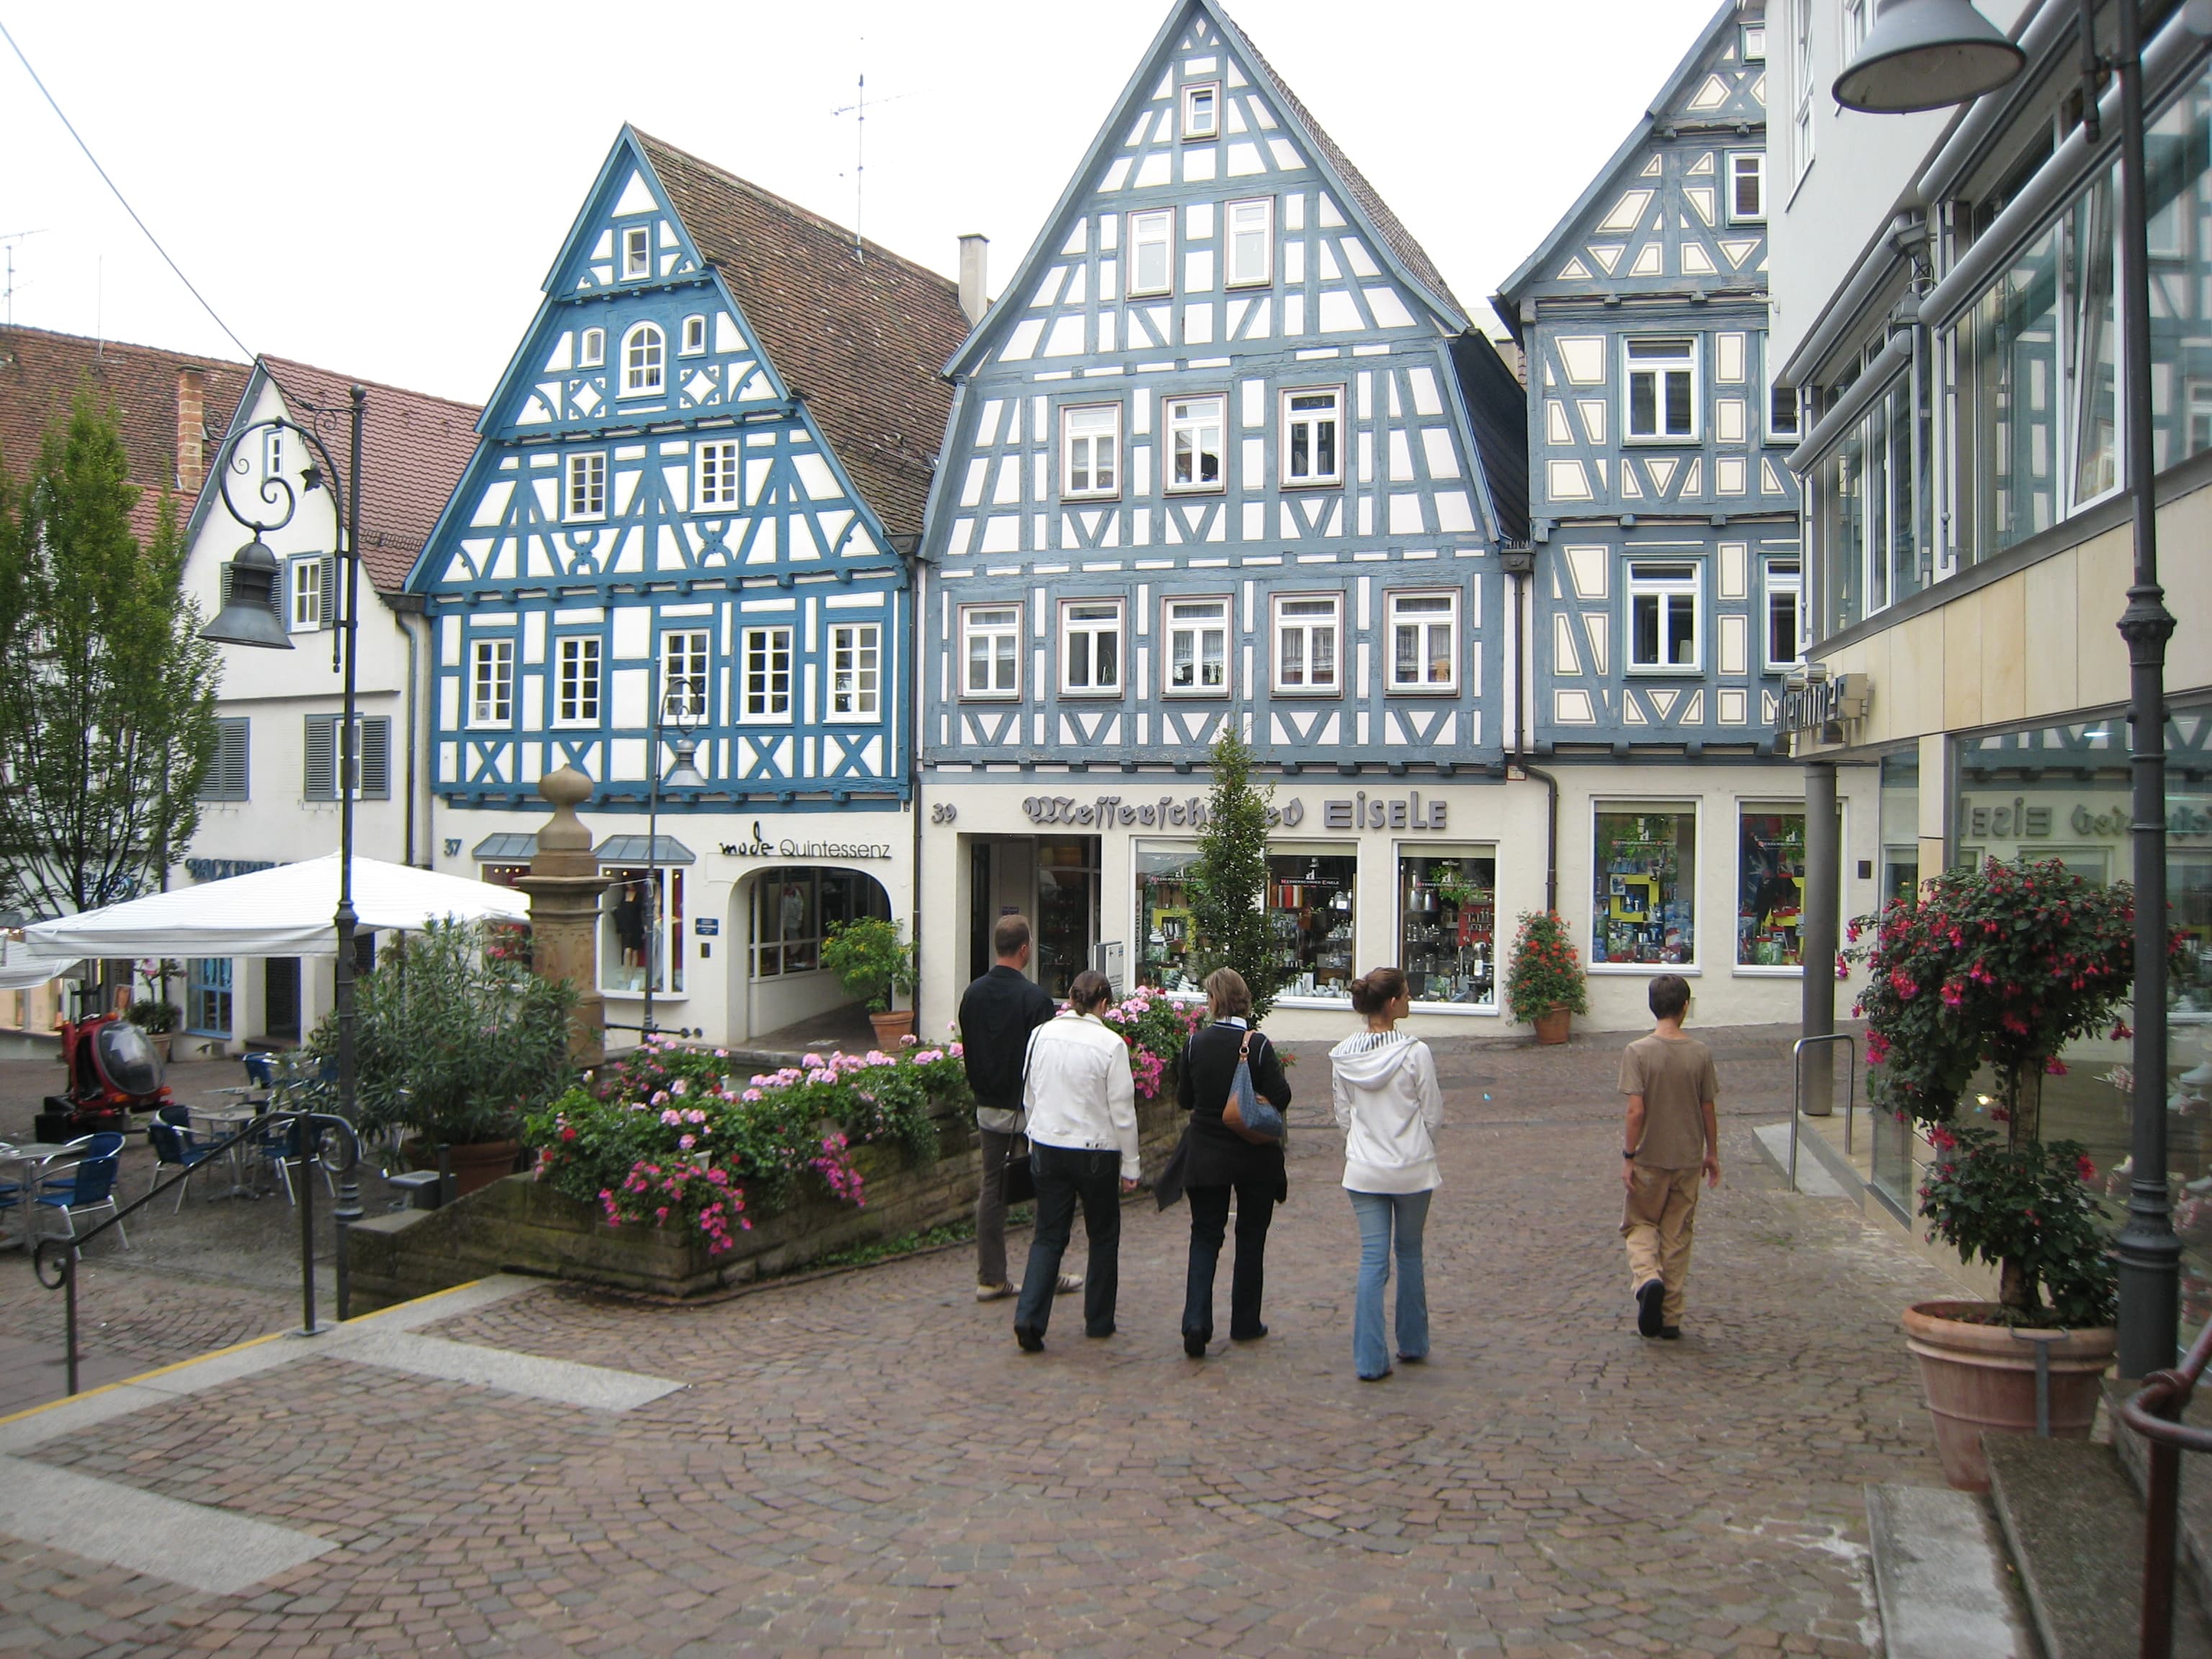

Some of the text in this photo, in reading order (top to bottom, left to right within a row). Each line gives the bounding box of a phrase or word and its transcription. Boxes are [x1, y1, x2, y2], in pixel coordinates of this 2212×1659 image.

[931, 802, 957, 824] 39
[1022, 796, 1304, 830] Messersched
[443, 838, 462, 858] 37
[719, 820, 892, 858] mode Quintessenz
